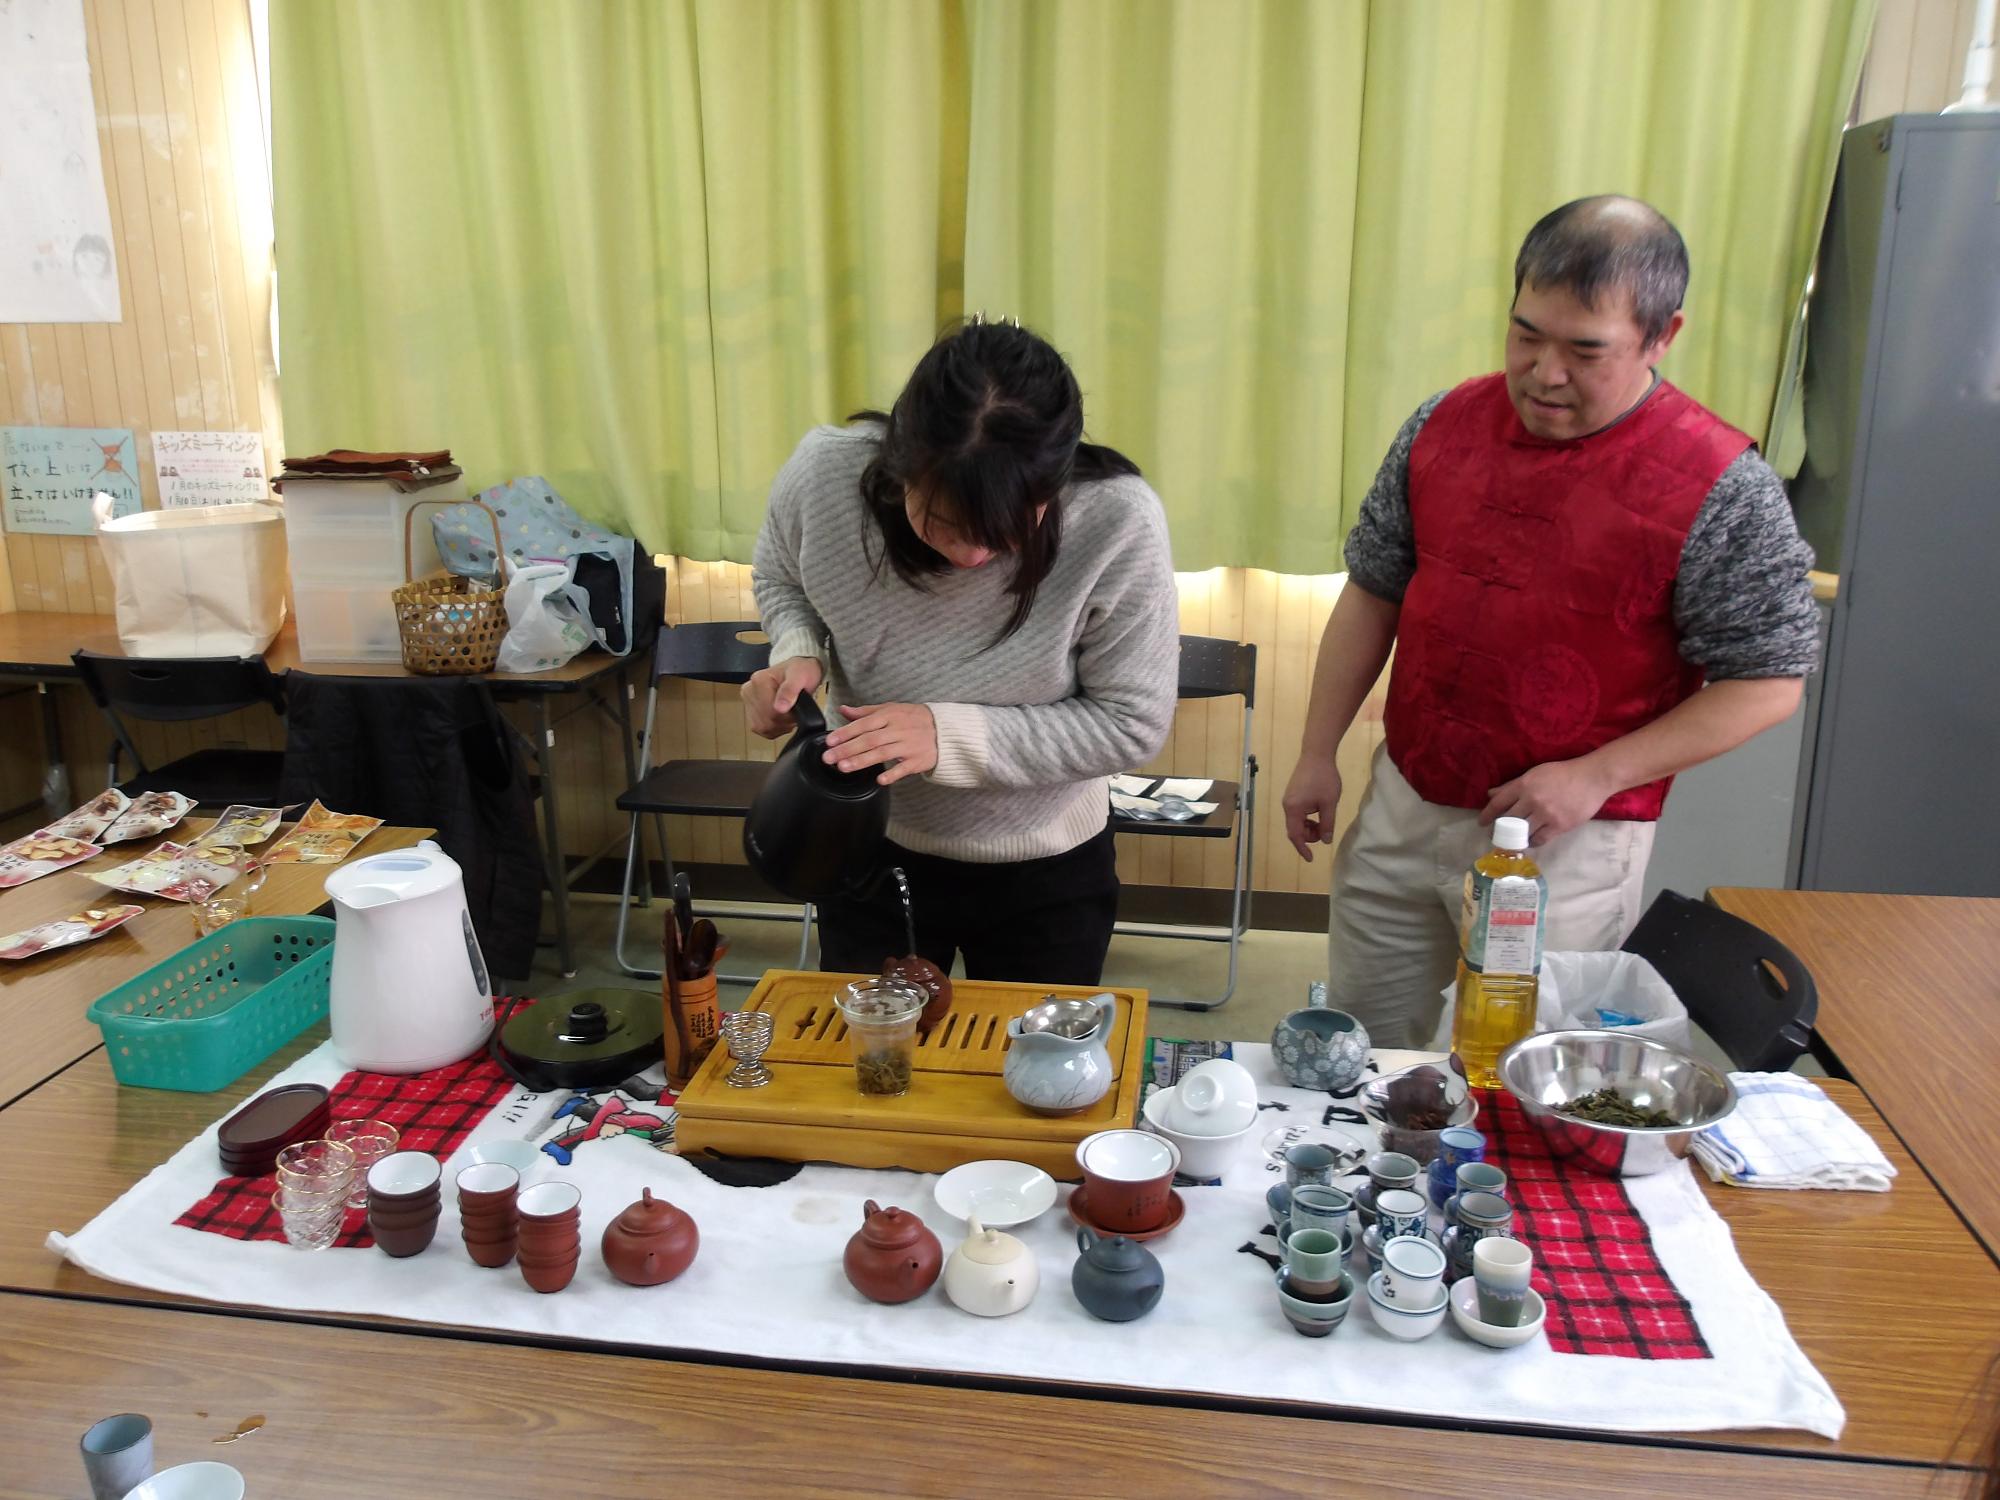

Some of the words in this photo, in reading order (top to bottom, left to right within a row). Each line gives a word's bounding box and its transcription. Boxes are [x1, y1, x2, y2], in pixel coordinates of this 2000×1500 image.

[158, 436, 258, 455] キッズミーティング
